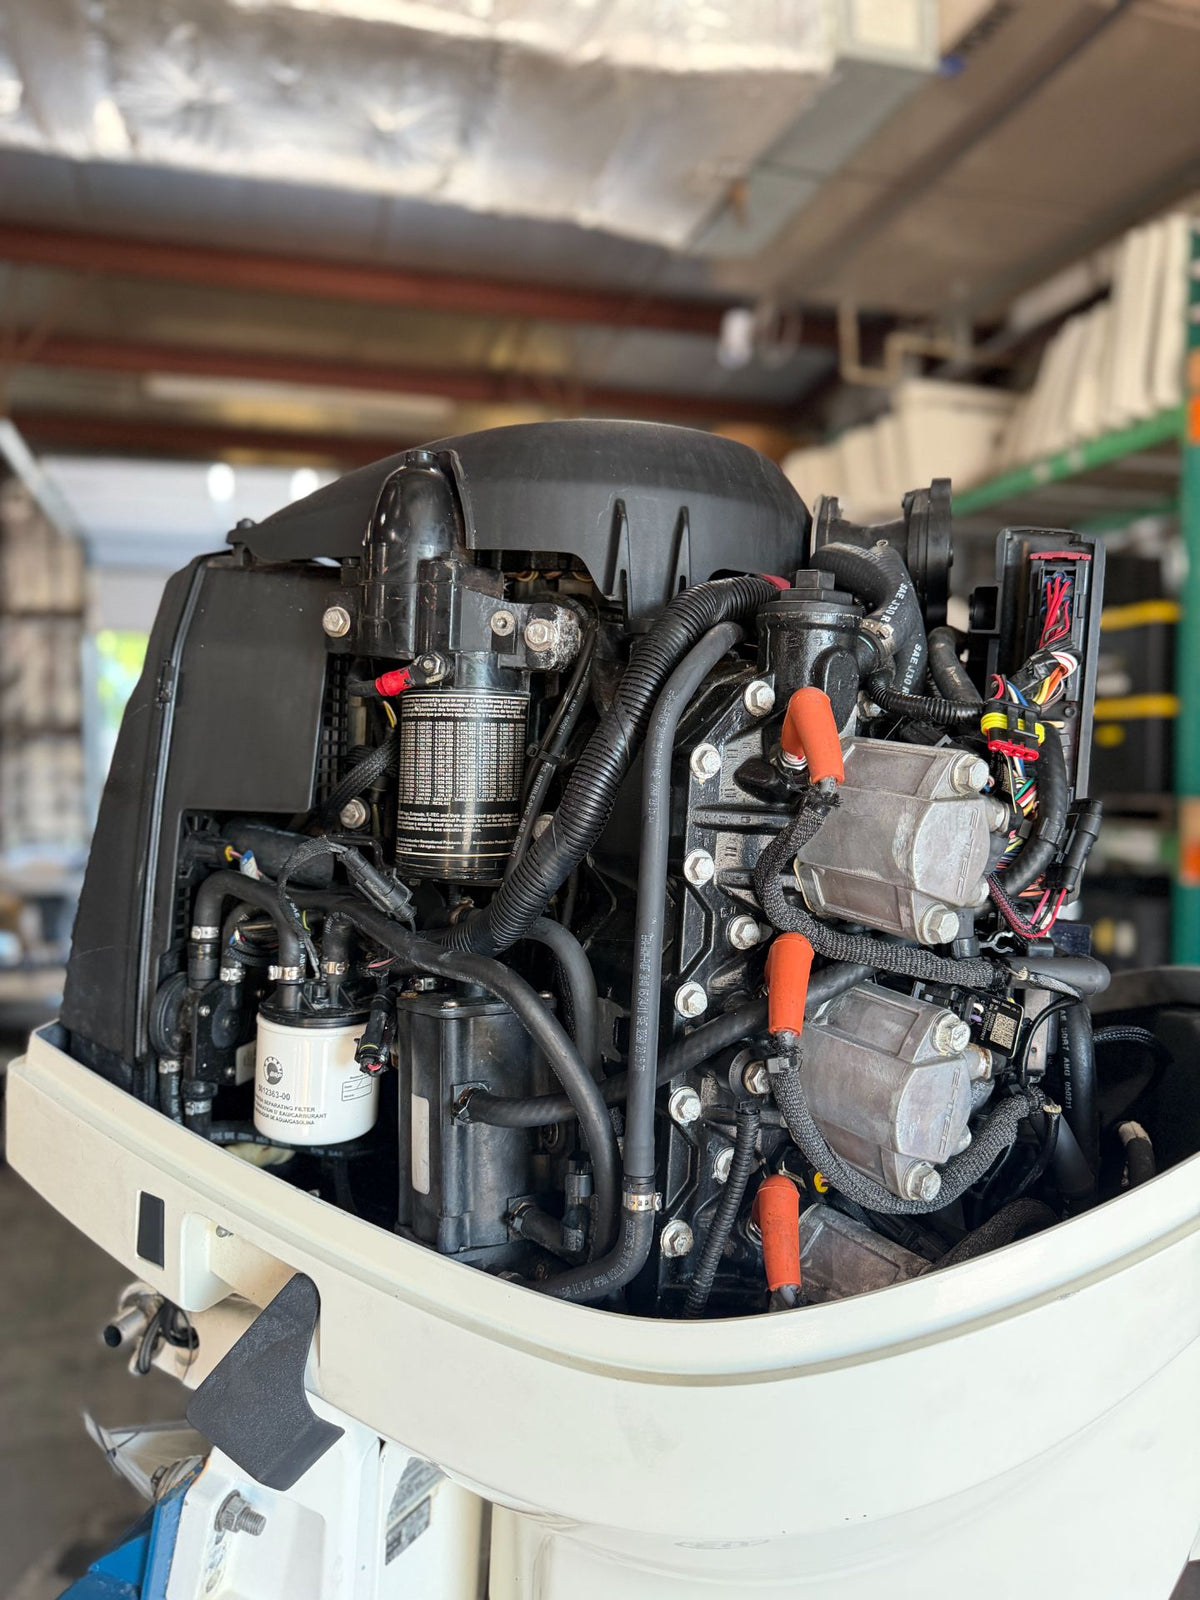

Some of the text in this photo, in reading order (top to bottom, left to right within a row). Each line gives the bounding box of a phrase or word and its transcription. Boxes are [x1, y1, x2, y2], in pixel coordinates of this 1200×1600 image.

[894, 582, 908, 600] SAE
[886, 600, 900, 615] J30
[910, 643, 922, 665] SAE
[903, 665, 915, 686] J30
[524, 774, 544, 816] NITRILE-PVC
